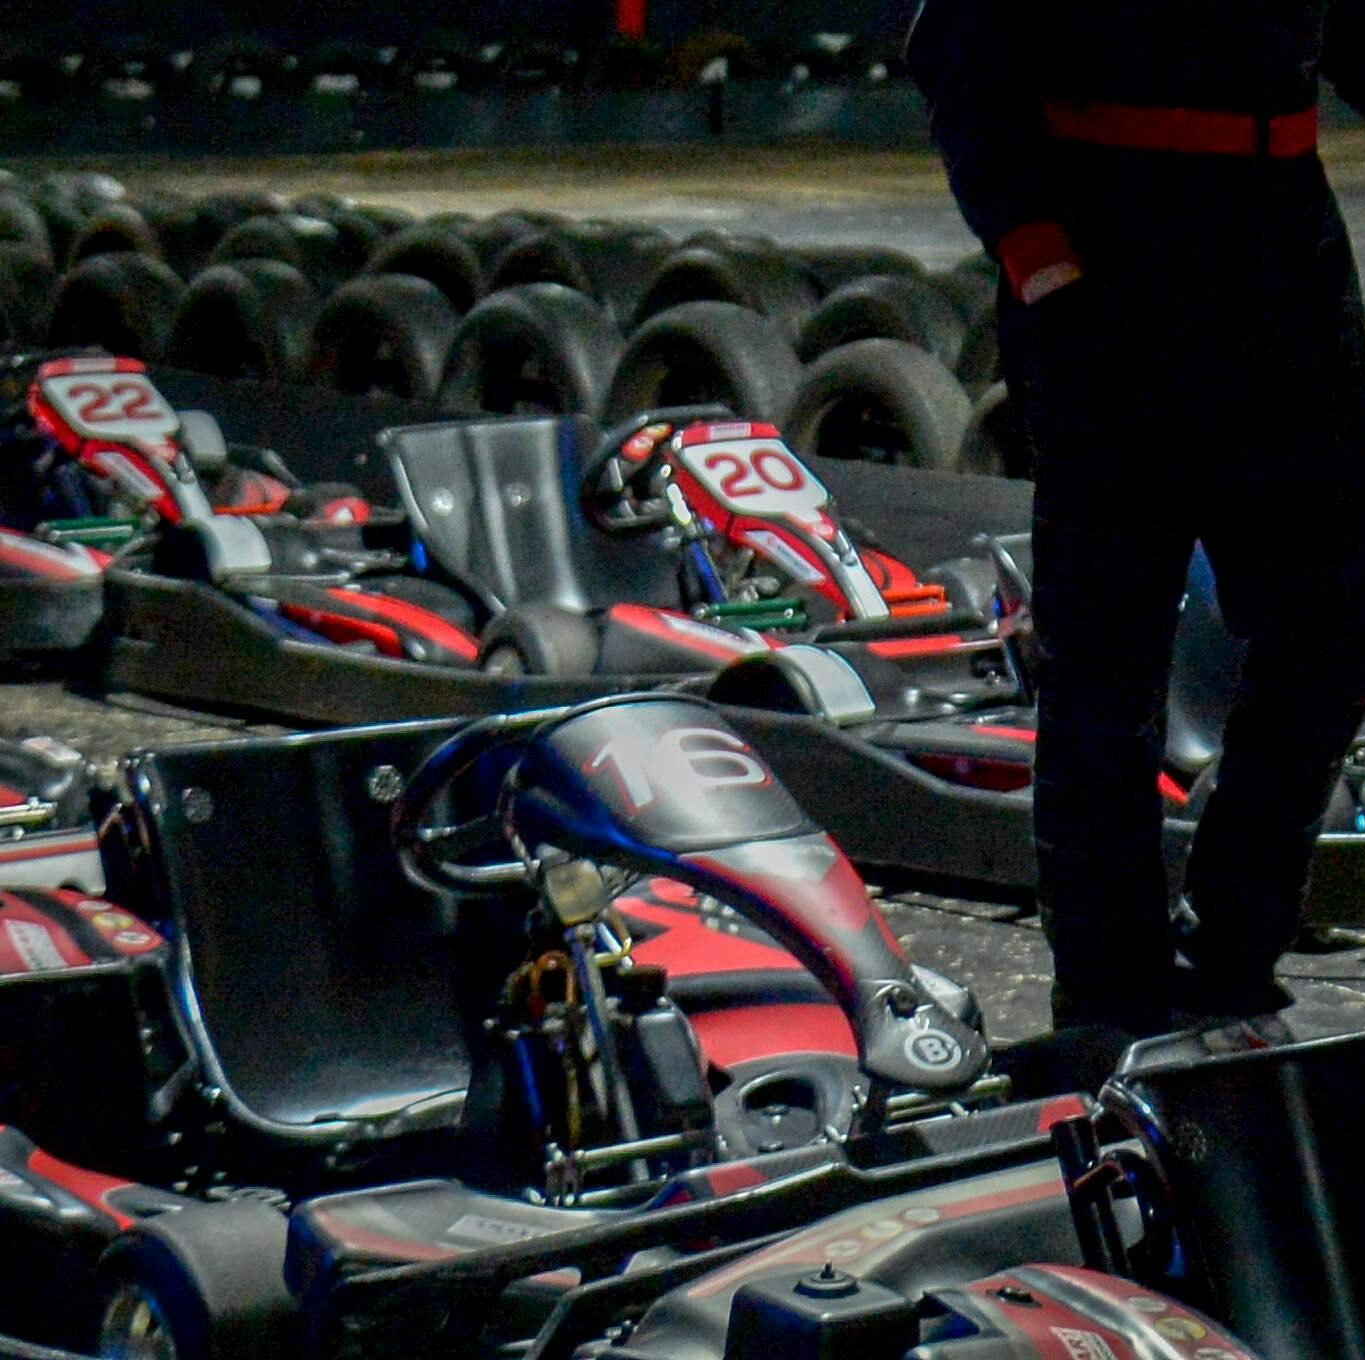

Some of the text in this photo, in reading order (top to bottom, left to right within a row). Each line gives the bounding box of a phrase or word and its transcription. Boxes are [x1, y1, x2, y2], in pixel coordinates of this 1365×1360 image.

[67, 381, 162, 422] 22
[704, 448, 804, 498] 20
[580, 725, 773, 817] 16
